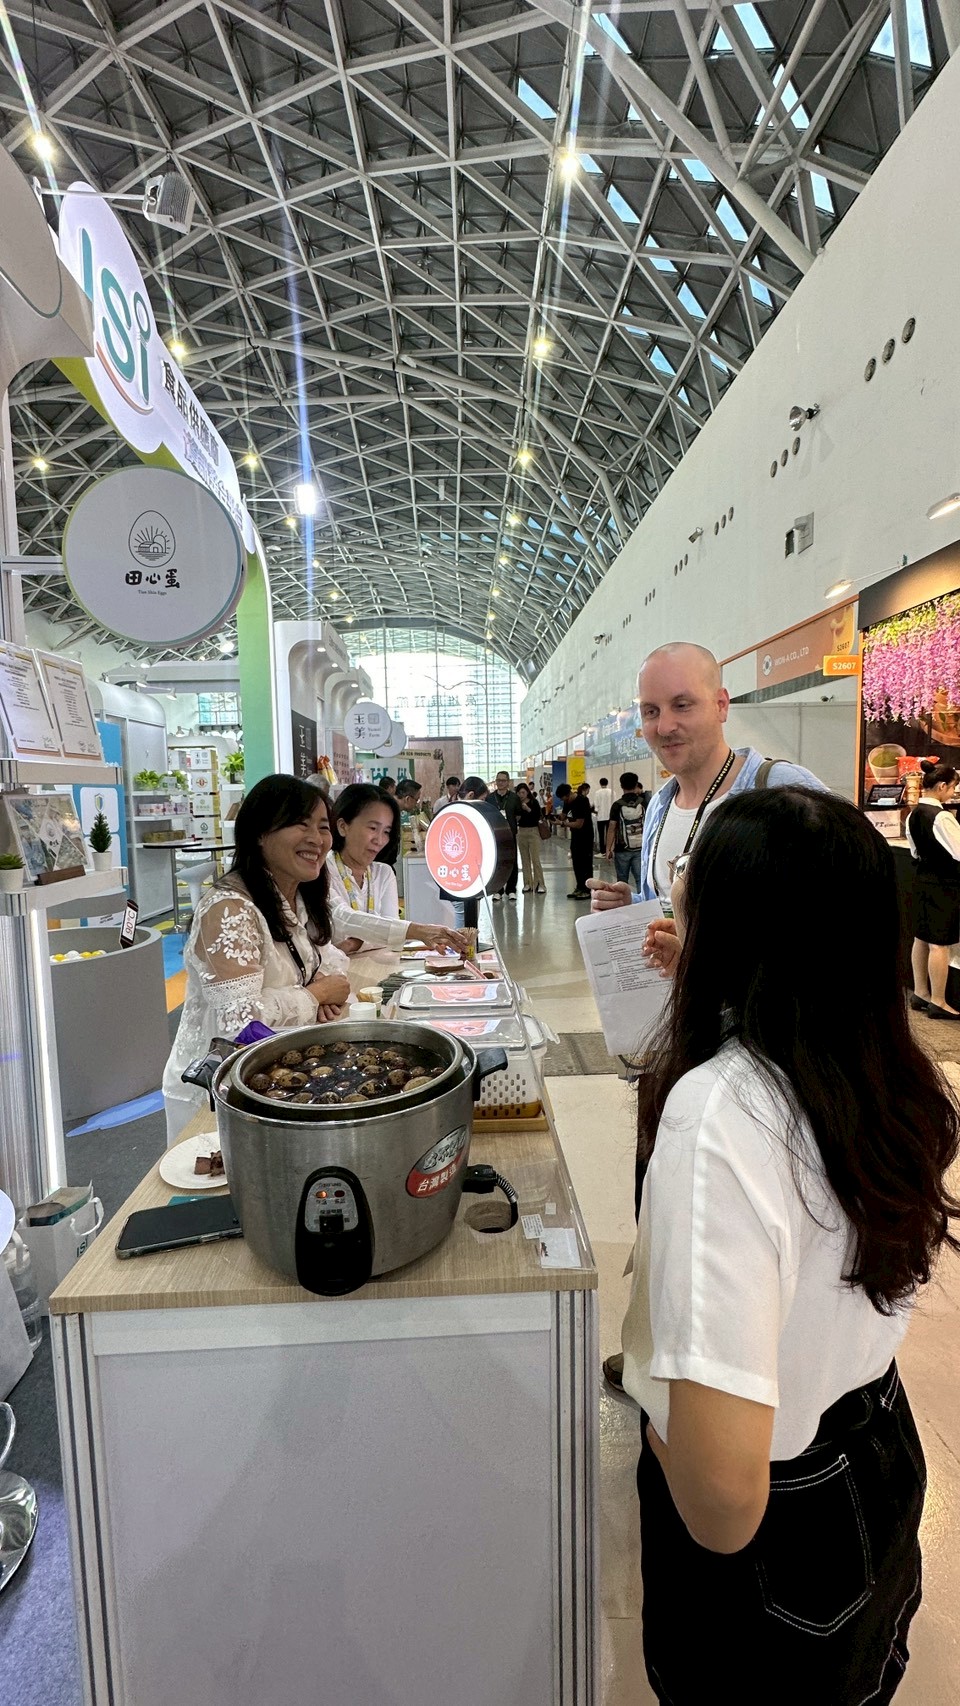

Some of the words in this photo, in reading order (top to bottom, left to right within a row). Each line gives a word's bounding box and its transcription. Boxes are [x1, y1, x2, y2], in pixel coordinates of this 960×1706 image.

[125, 568, 181, 589] 田心蛋
[800, 646, 809, 657] LTD
[837, 642, 850, 651] S2607
[832, 662, 856, 670] S2607
[437, 864, 471, 882] 田心蛋
